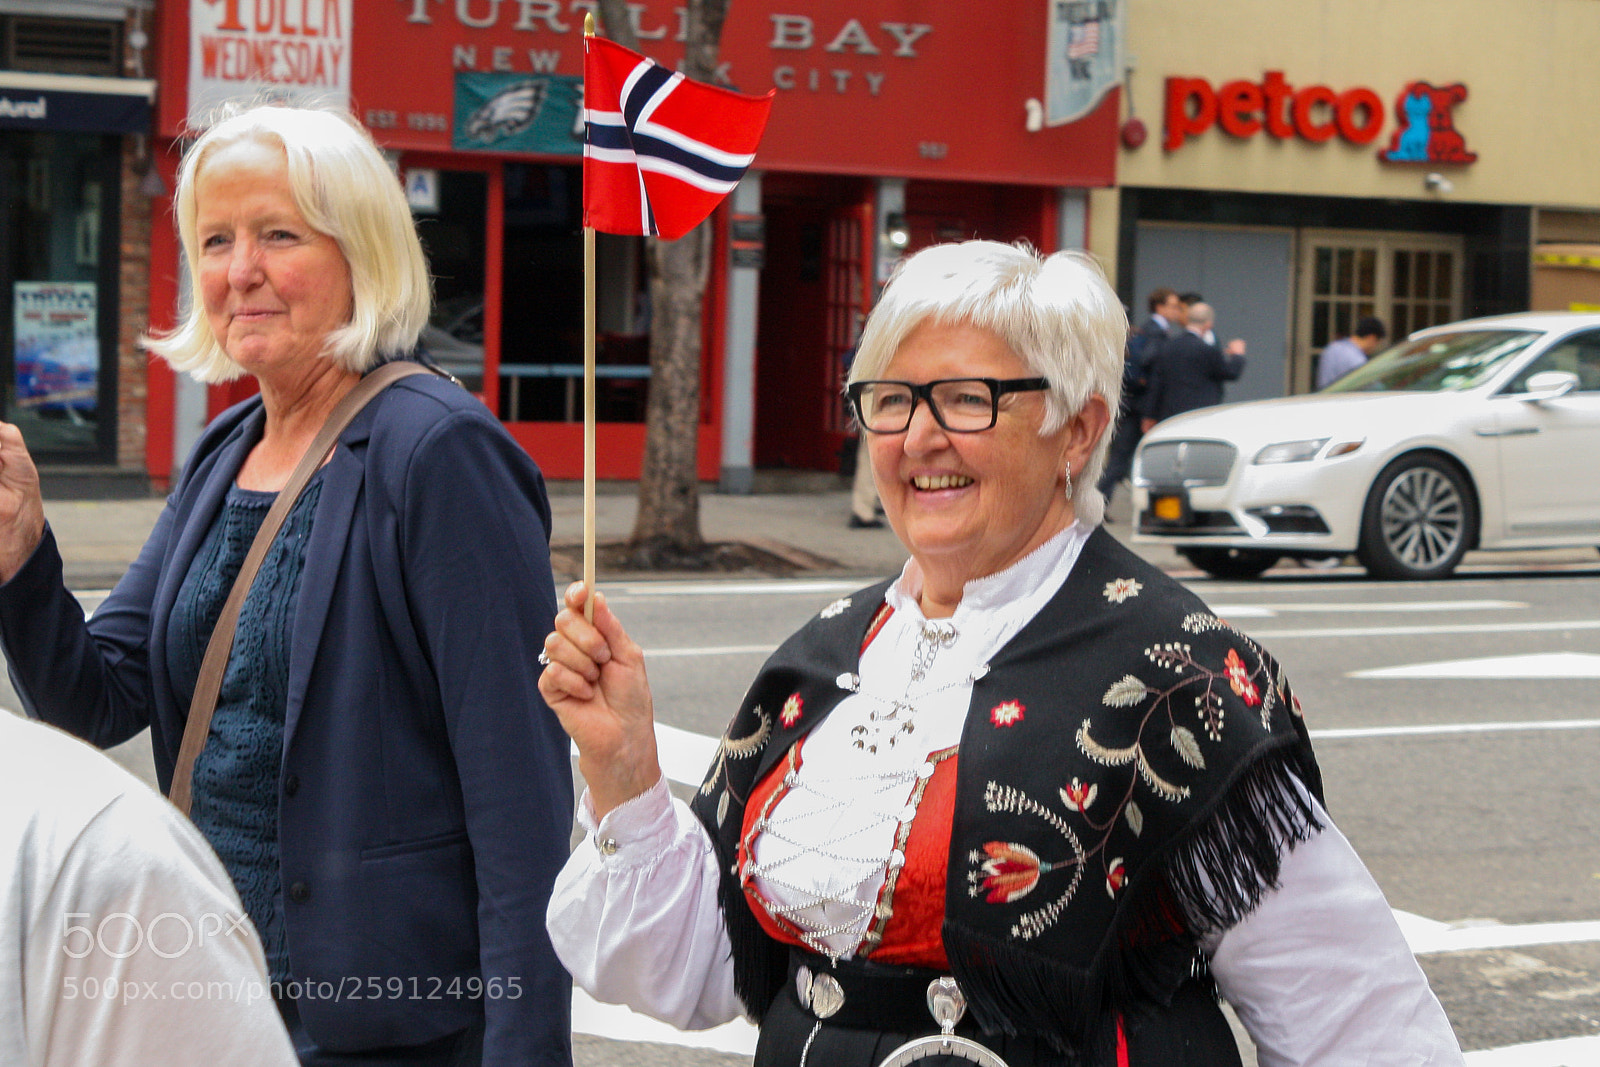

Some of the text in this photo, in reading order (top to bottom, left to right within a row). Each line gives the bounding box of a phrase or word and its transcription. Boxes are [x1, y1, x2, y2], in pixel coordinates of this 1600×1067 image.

[769, 13, 932, 57] BAY
[200, 36, 342, 86] WEDNESDAY
[453, 44, 884, 96] NEW CITY
[1163, 70, 1386, 153] petco
[412, 174, 429, 194] A
